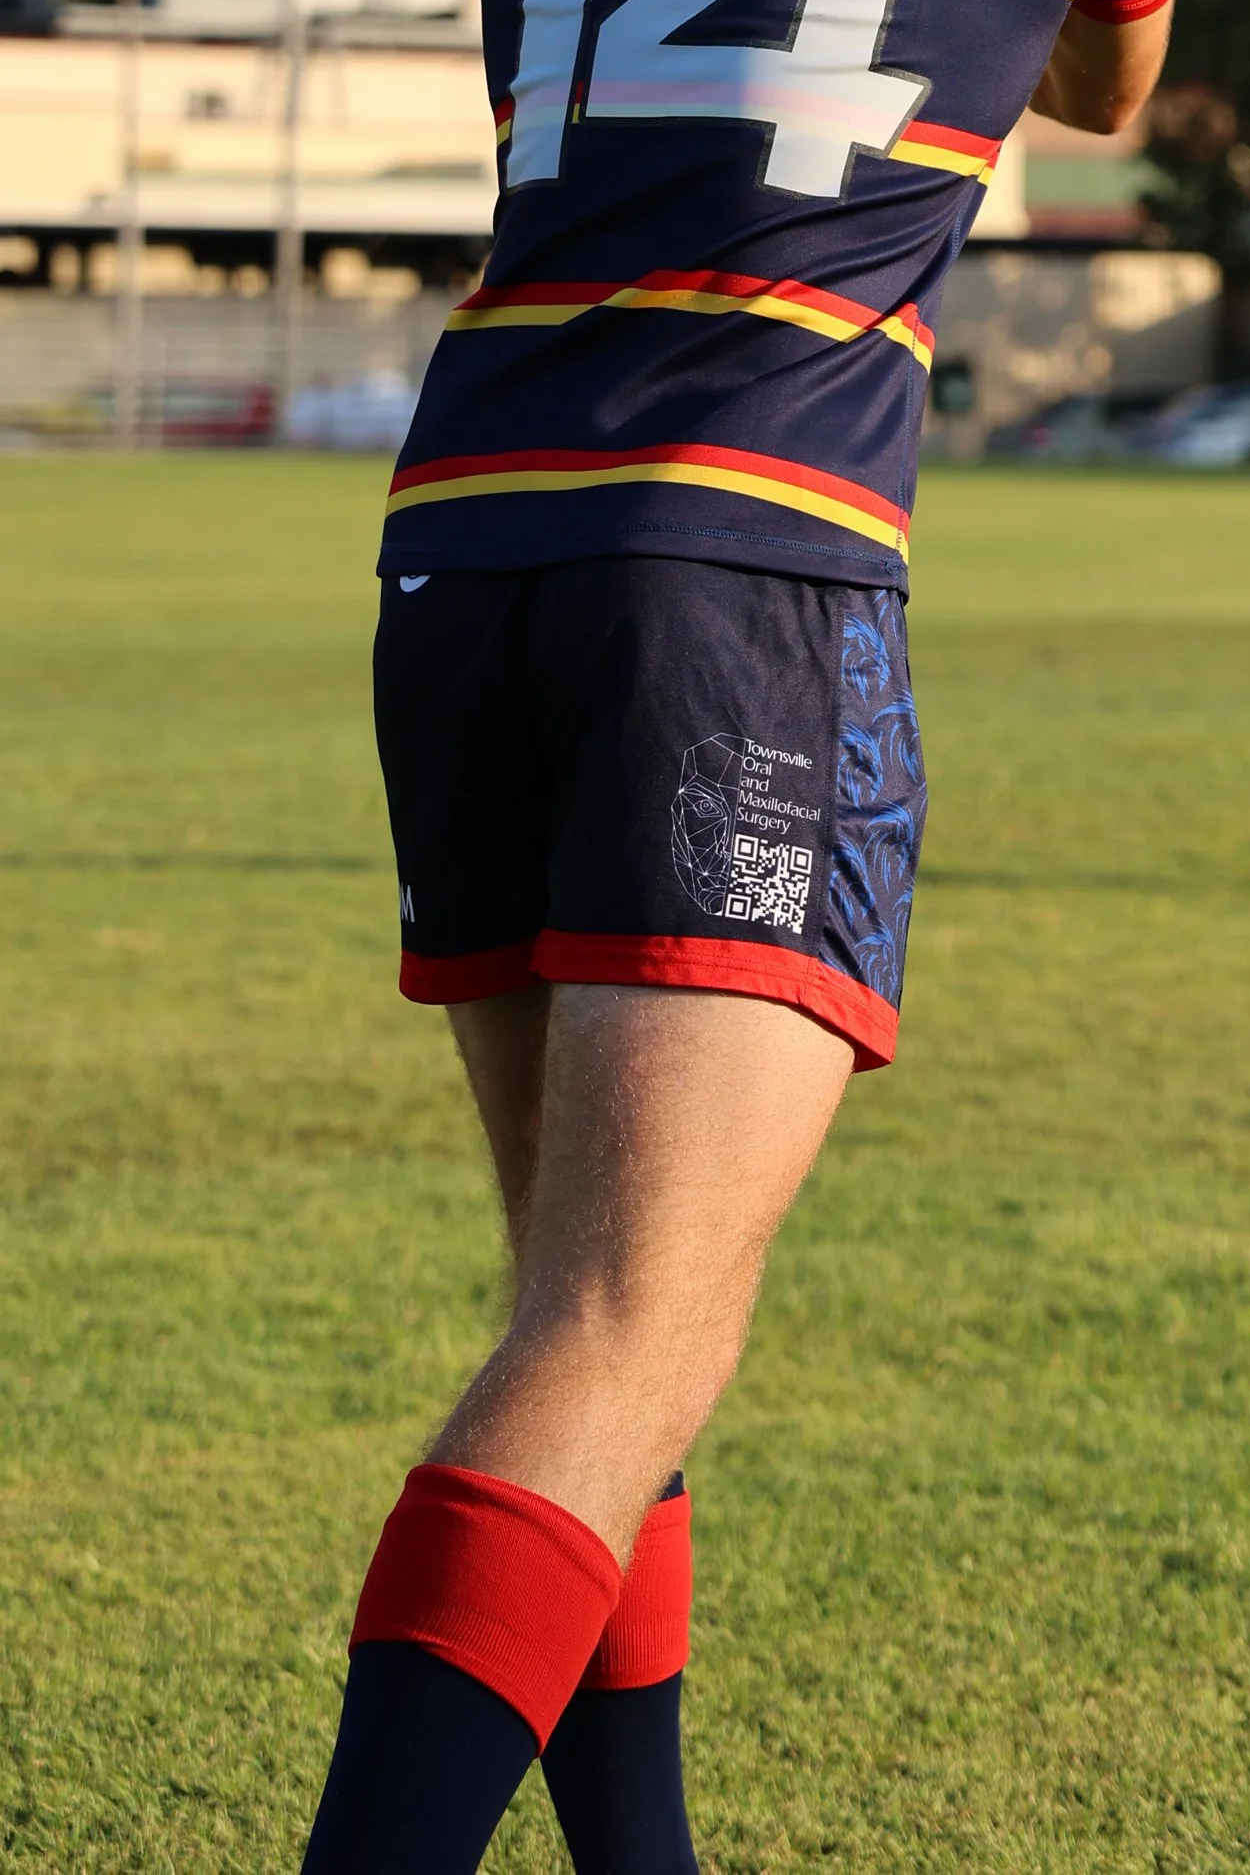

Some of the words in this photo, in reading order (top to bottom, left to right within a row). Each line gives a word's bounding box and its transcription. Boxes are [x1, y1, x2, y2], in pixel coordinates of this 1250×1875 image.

[742, 756, 772, 775] Oral
[746, 739, 813, 769] Townsville
[740, 776, 769, 793] and
[738, 790, 821, 822] Maxillofacial
[736, 807, 791, 835] Surgery
